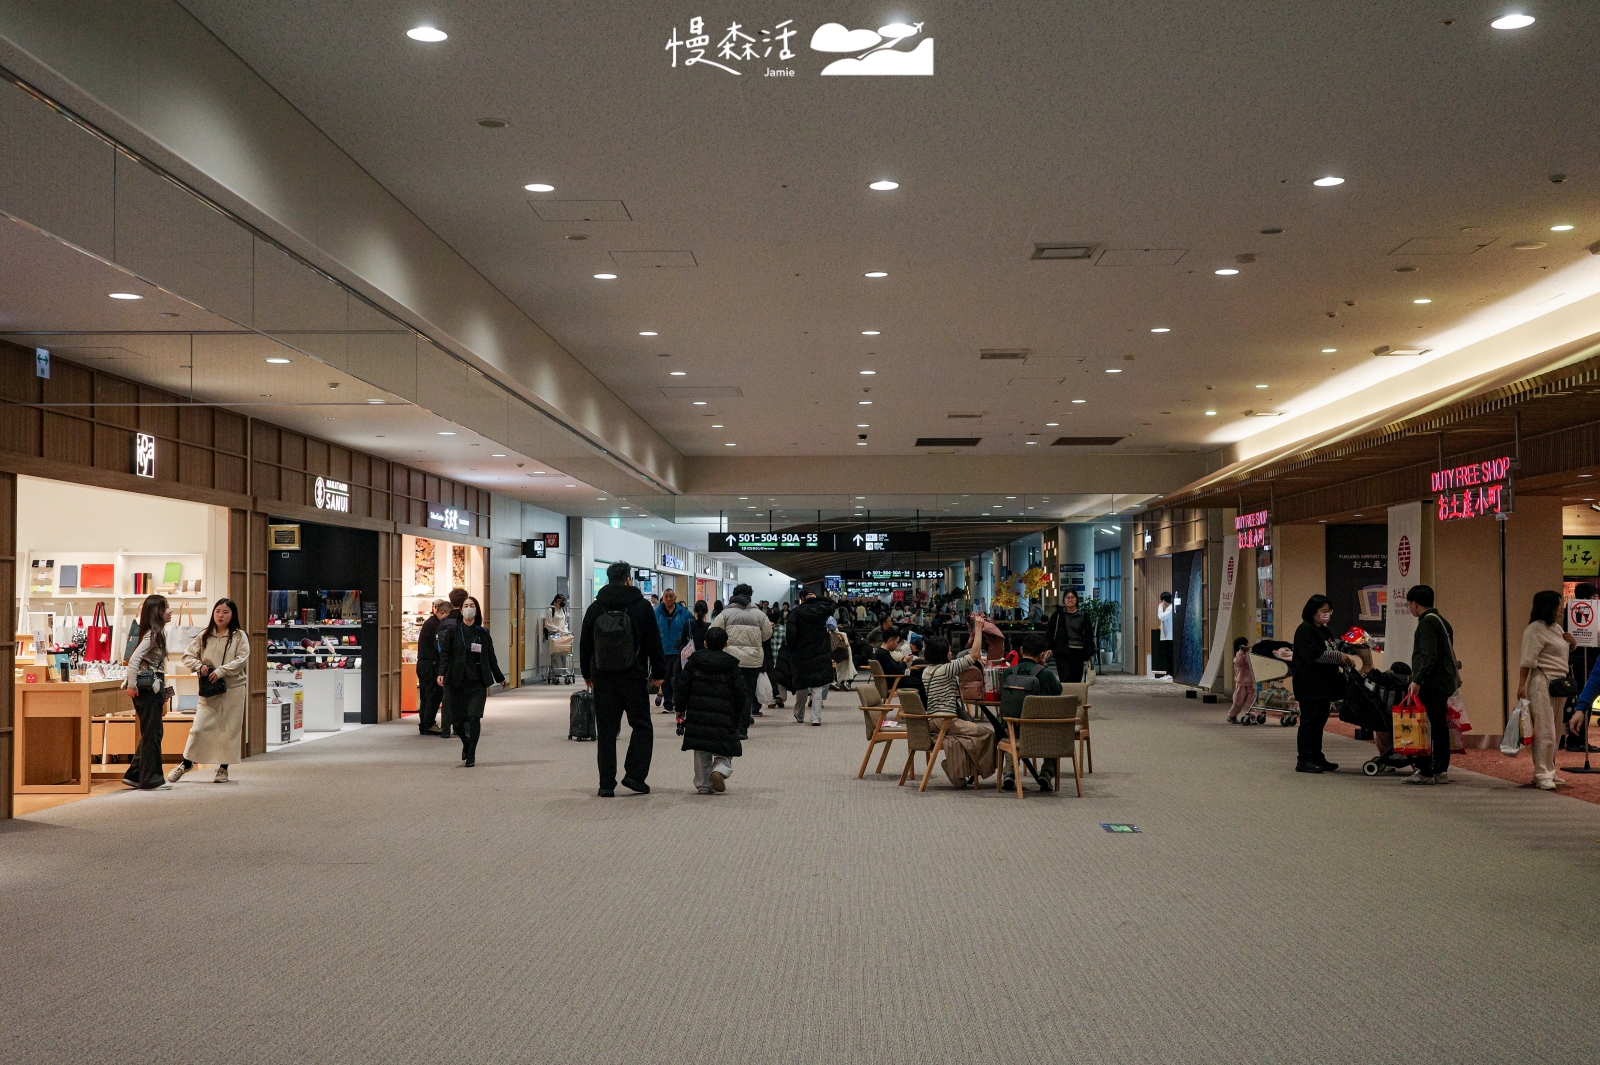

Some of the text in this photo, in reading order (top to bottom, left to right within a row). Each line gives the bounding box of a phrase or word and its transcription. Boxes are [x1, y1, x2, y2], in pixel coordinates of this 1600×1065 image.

[1431, 456, 1510, 492] DUTY FREE SHOP
[325, 492, 348, 513] SANUI
[1438, 484, 1502, 521] お土産小町
[1353, 560, 1387, 569] お土産
